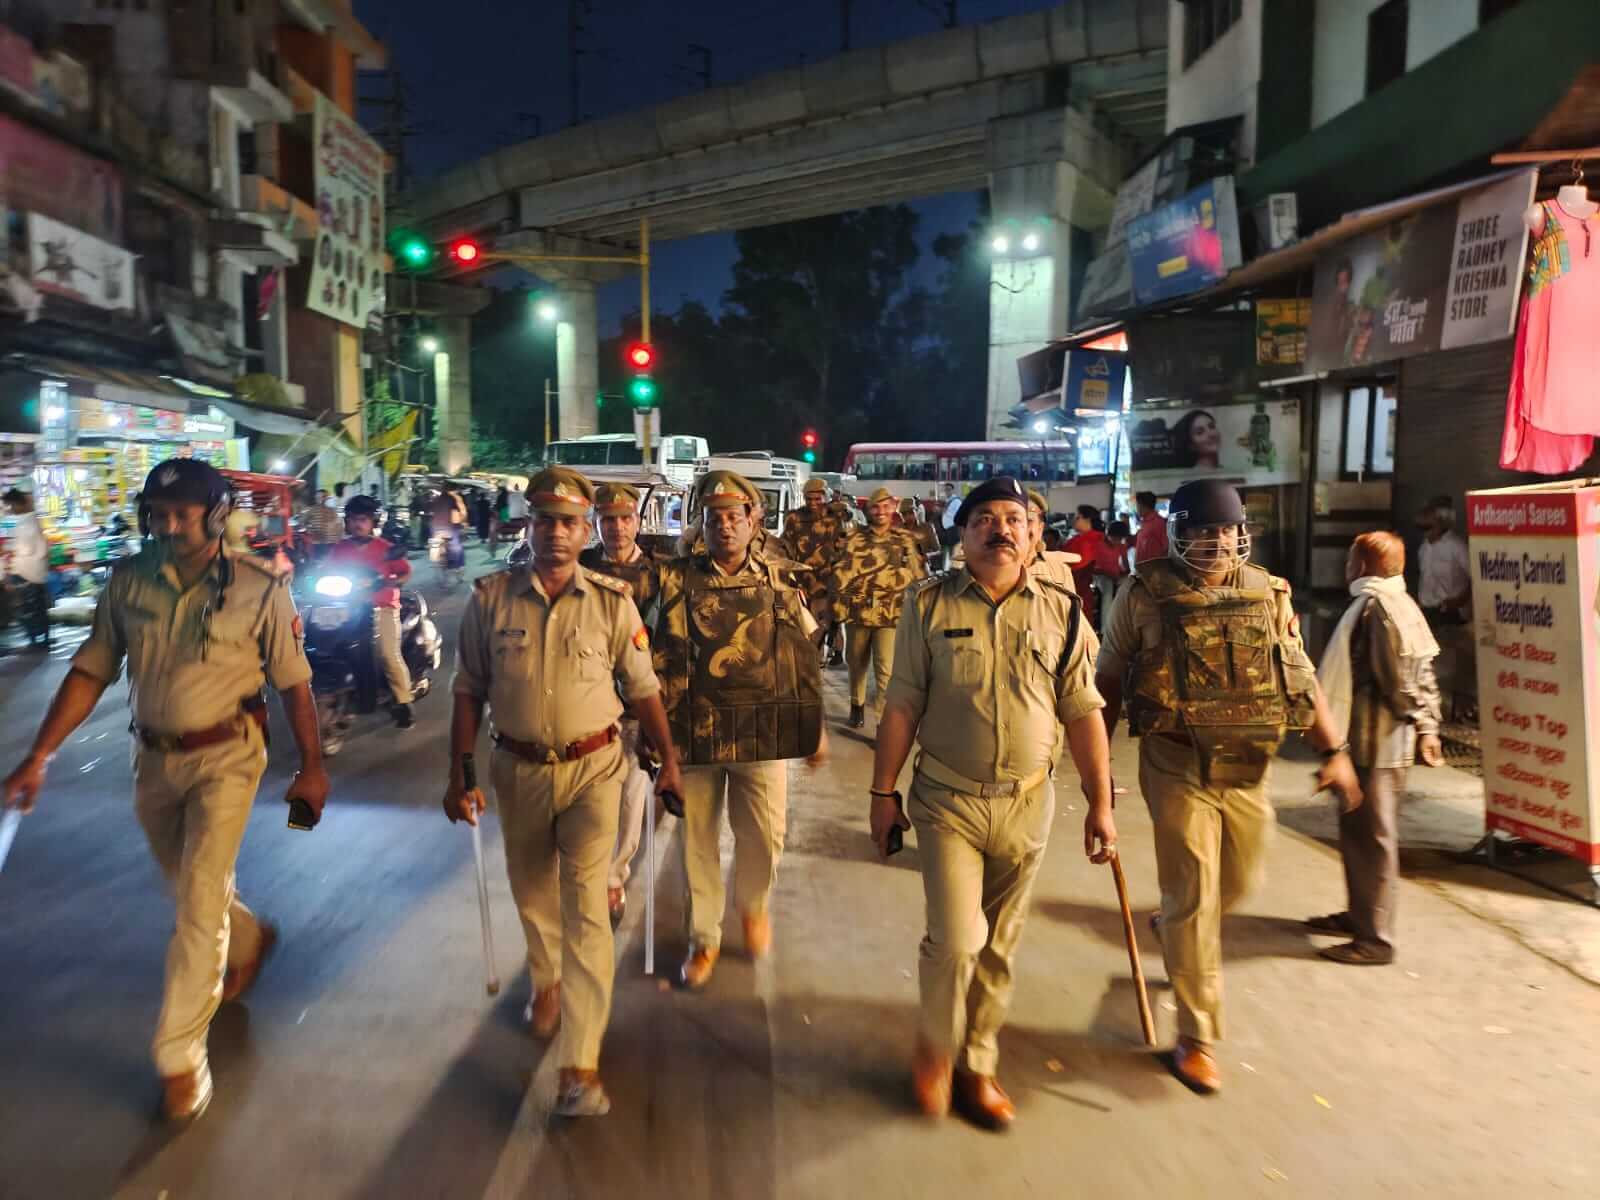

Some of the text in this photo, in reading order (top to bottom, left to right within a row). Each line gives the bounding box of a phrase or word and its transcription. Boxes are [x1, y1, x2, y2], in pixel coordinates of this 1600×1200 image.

[1460, 215, 1500, 244] SHREE
[1457, 239, 1507, 269] RADHEY
[1453, 264, 1507, 295] KRISHNA
[1451, 296, 1488, 321] STORE
[1474, 503, 1526, 531] Ardhangini
[1528, 502, 1567, 526] Sarees
[1479, 551, 1566, 590] Wedding Carnival
[1494, 593, 1553, 633] Readymade
[1535, 714, 1568, 739] Top
